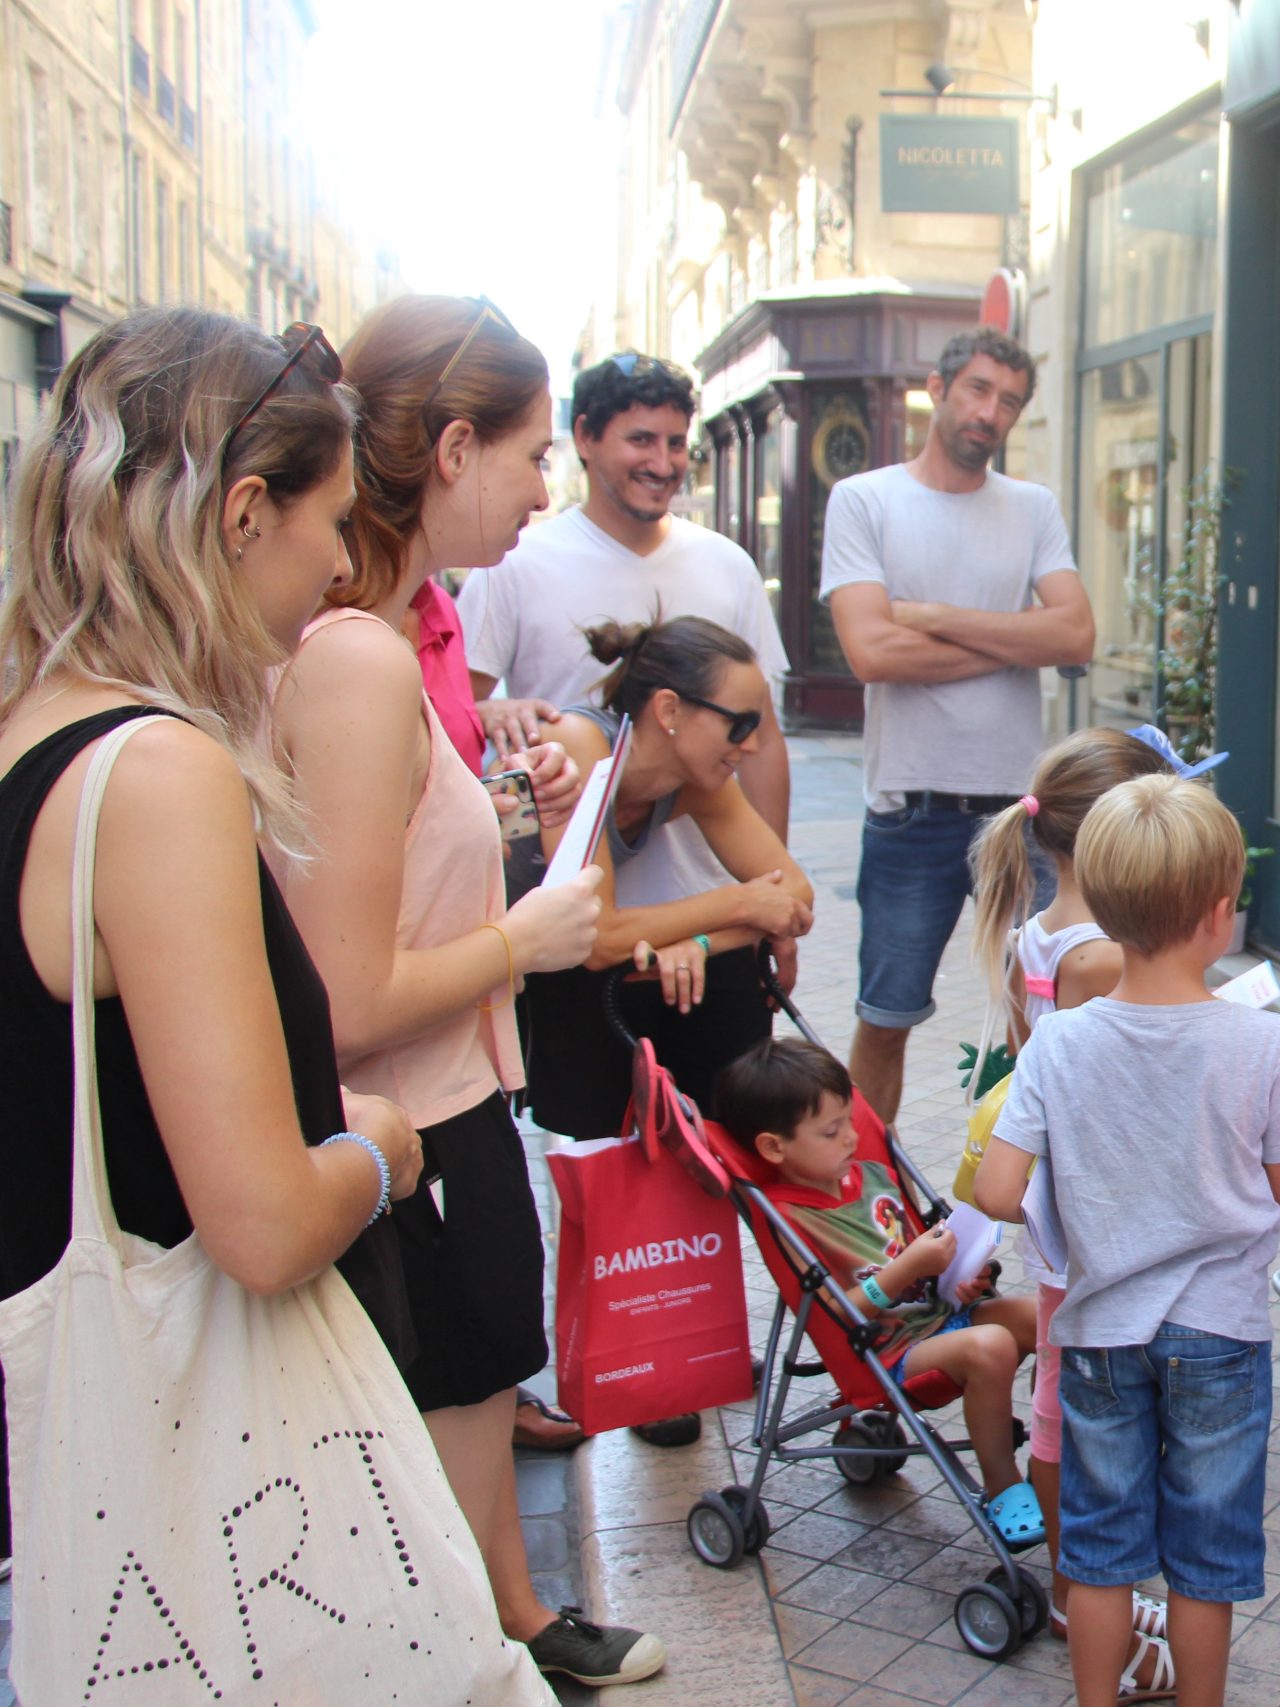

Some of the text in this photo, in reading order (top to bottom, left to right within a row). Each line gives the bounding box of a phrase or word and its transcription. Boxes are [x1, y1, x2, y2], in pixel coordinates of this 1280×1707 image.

[897, 146, 1004, 168] NICOLETTA
[594, 1232, 722, 1280] BAMBINO
[608, 1282, 713, 1312] Spécialiste Chaussures
[595, 1361, 655, 1384] BORDEAUX
[82, 1429, 420, 1707] ART
